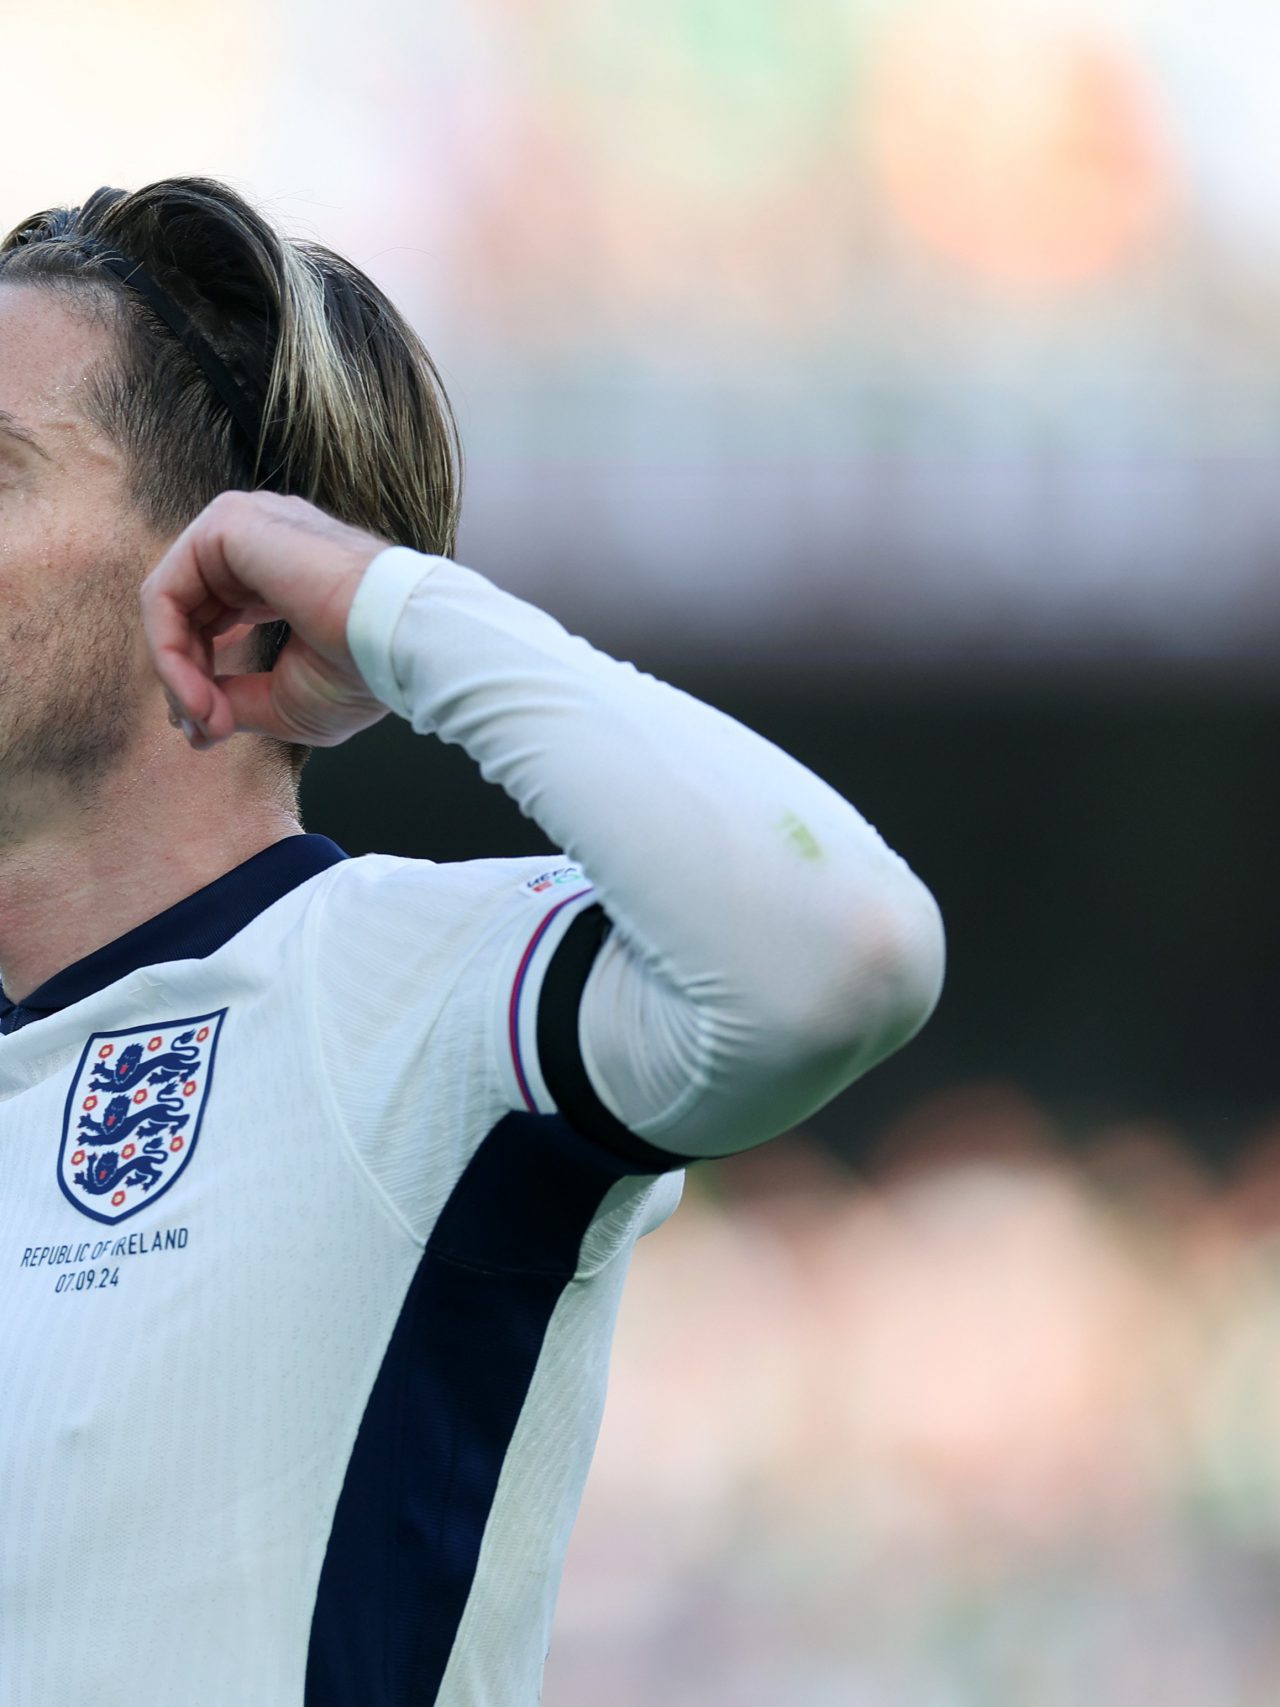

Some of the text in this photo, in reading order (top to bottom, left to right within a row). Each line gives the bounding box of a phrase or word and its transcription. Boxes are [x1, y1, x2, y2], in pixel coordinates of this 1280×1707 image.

[20, 1228, 188, 1267] REPUBLIC OF IRELAND
[55, 1267, 120, 1293] 07.09.24
